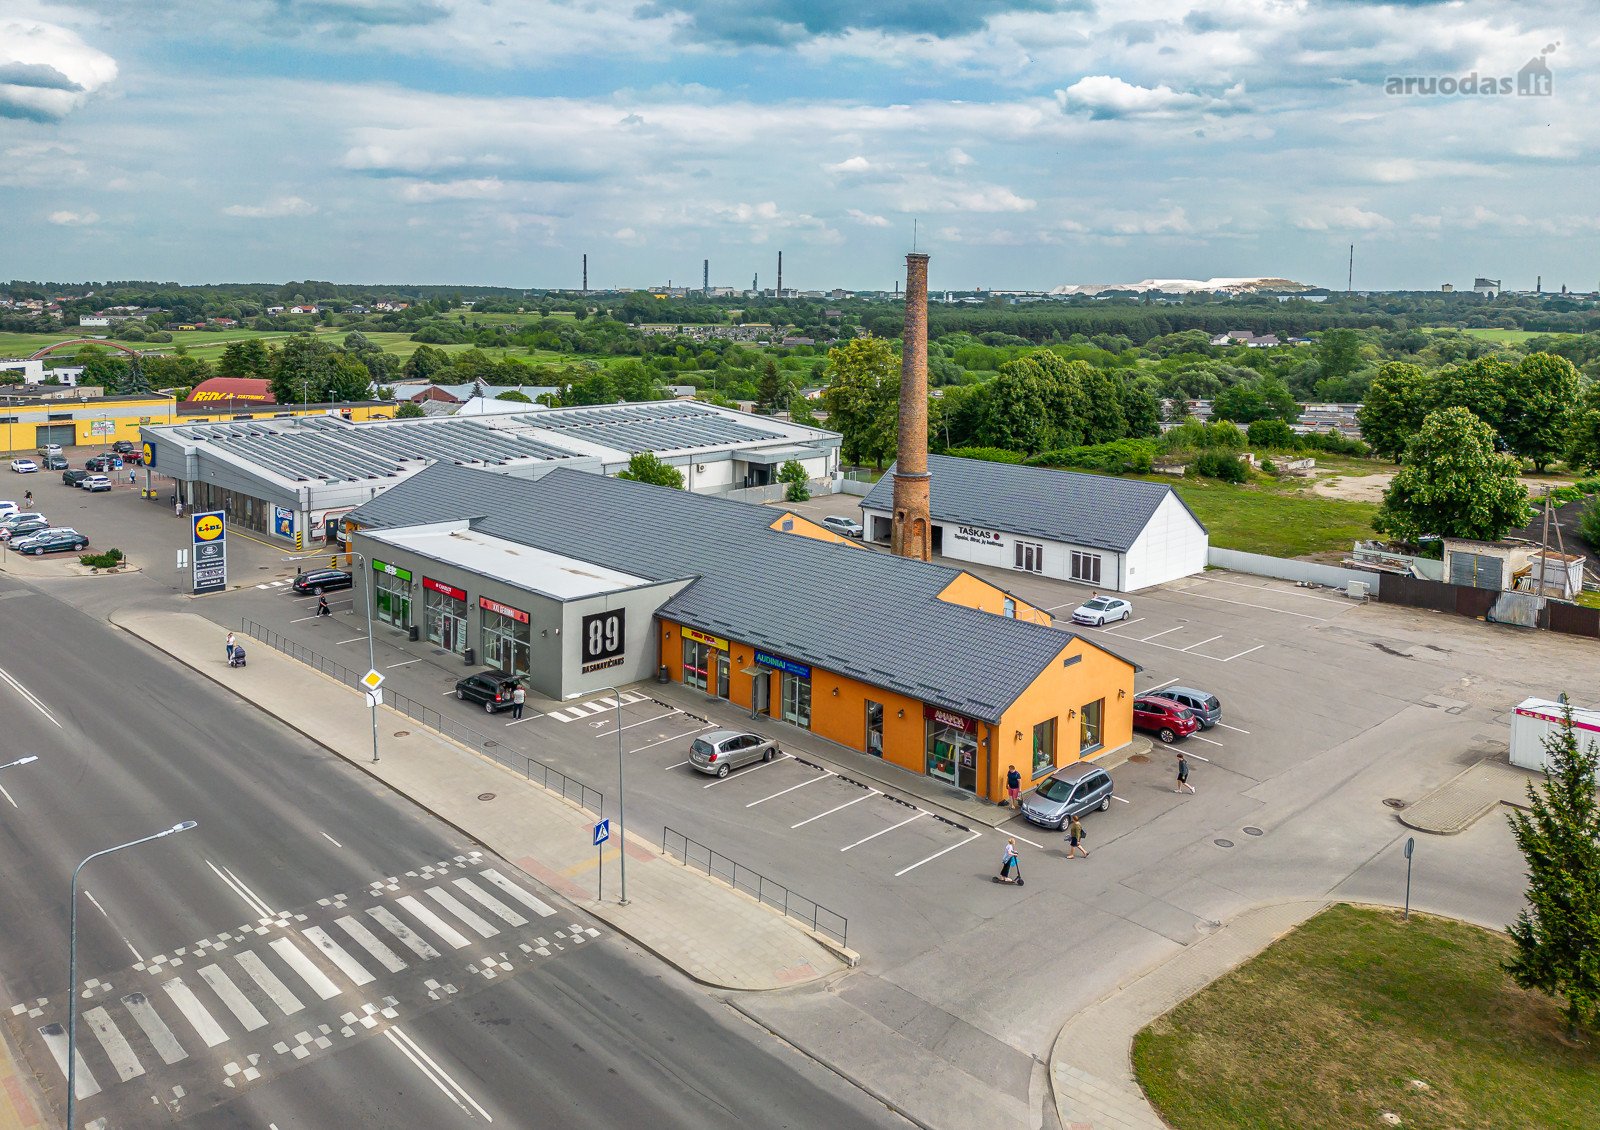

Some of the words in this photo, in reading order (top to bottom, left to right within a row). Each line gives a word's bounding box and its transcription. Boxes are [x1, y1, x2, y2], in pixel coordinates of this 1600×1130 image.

[958, 527, 990, 539] TAŠKAS
[589, 616, 619, 656] 89
[581, 656, 625, 675] BASANAVIČIAUS
